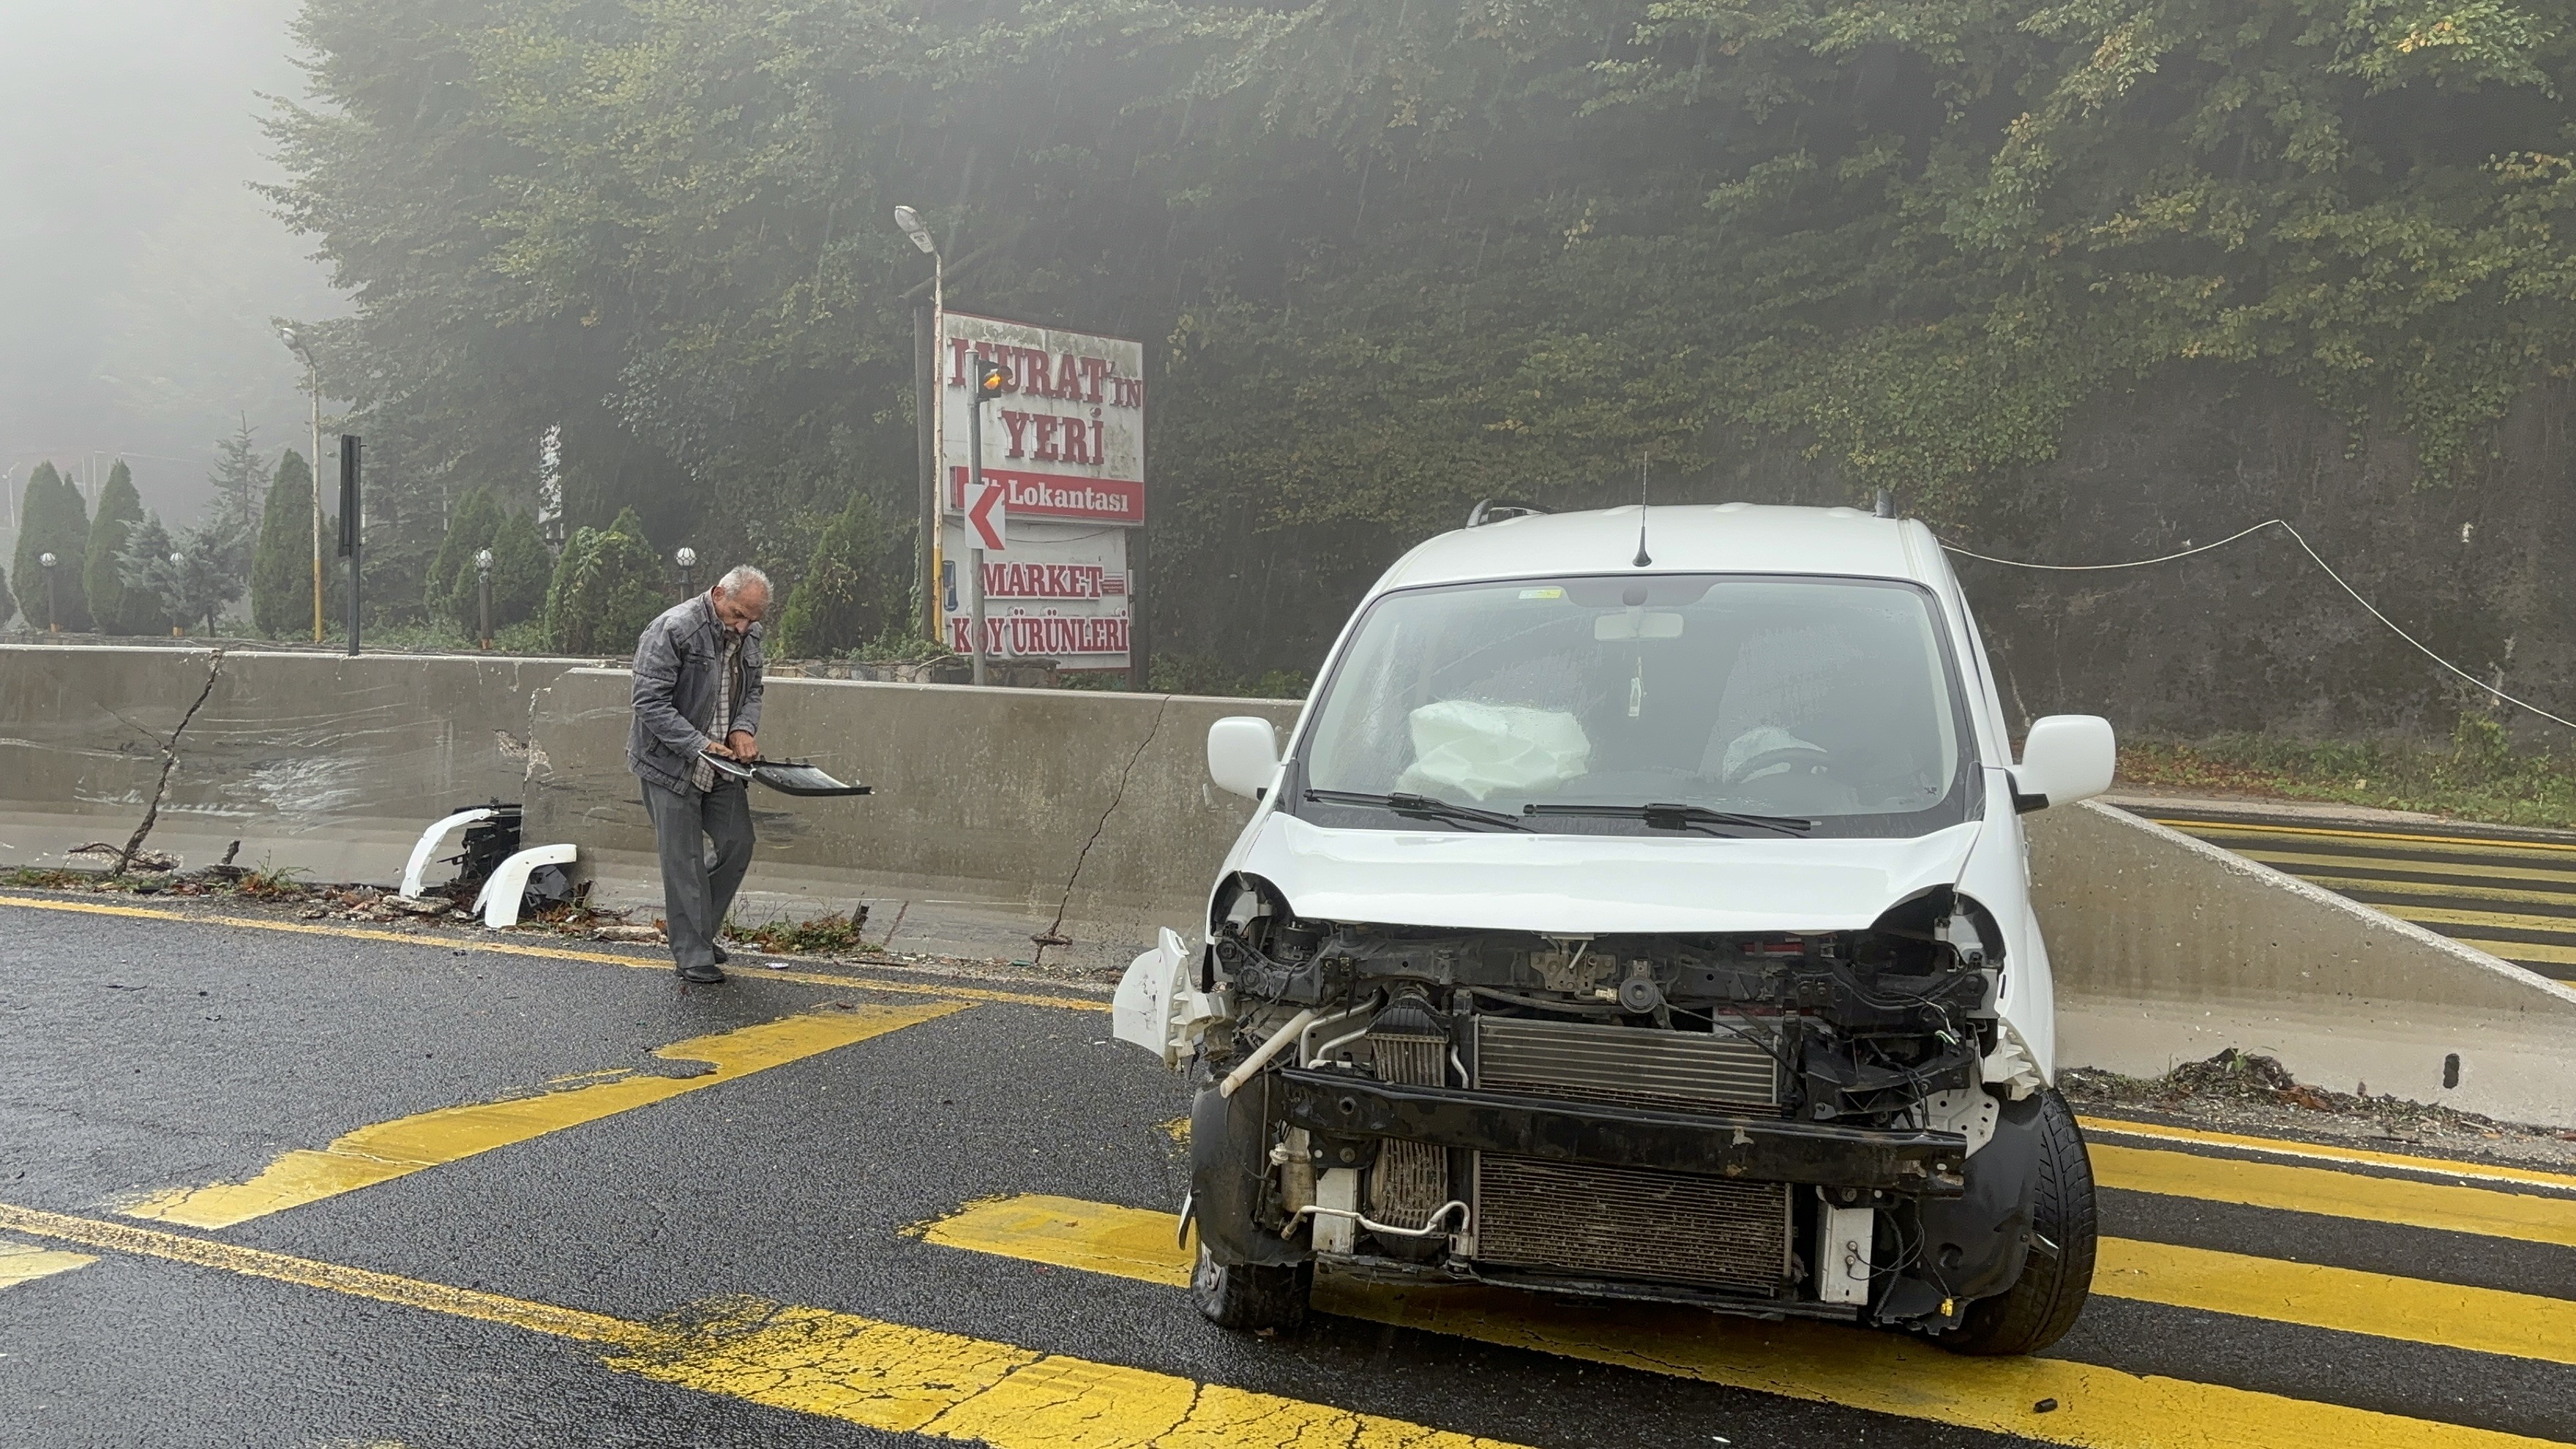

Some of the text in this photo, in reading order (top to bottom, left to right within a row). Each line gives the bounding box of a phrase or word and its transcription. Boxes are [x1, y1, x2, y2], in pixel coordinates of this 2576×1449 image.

[1000, 407, 1105, 465] YERİ
[1008, 479, 1129, 512] Lokantası
[983, 563, 1104, 597] MARKET
[952, 608, 1128, 653] KY ÜRÜNLERİ
